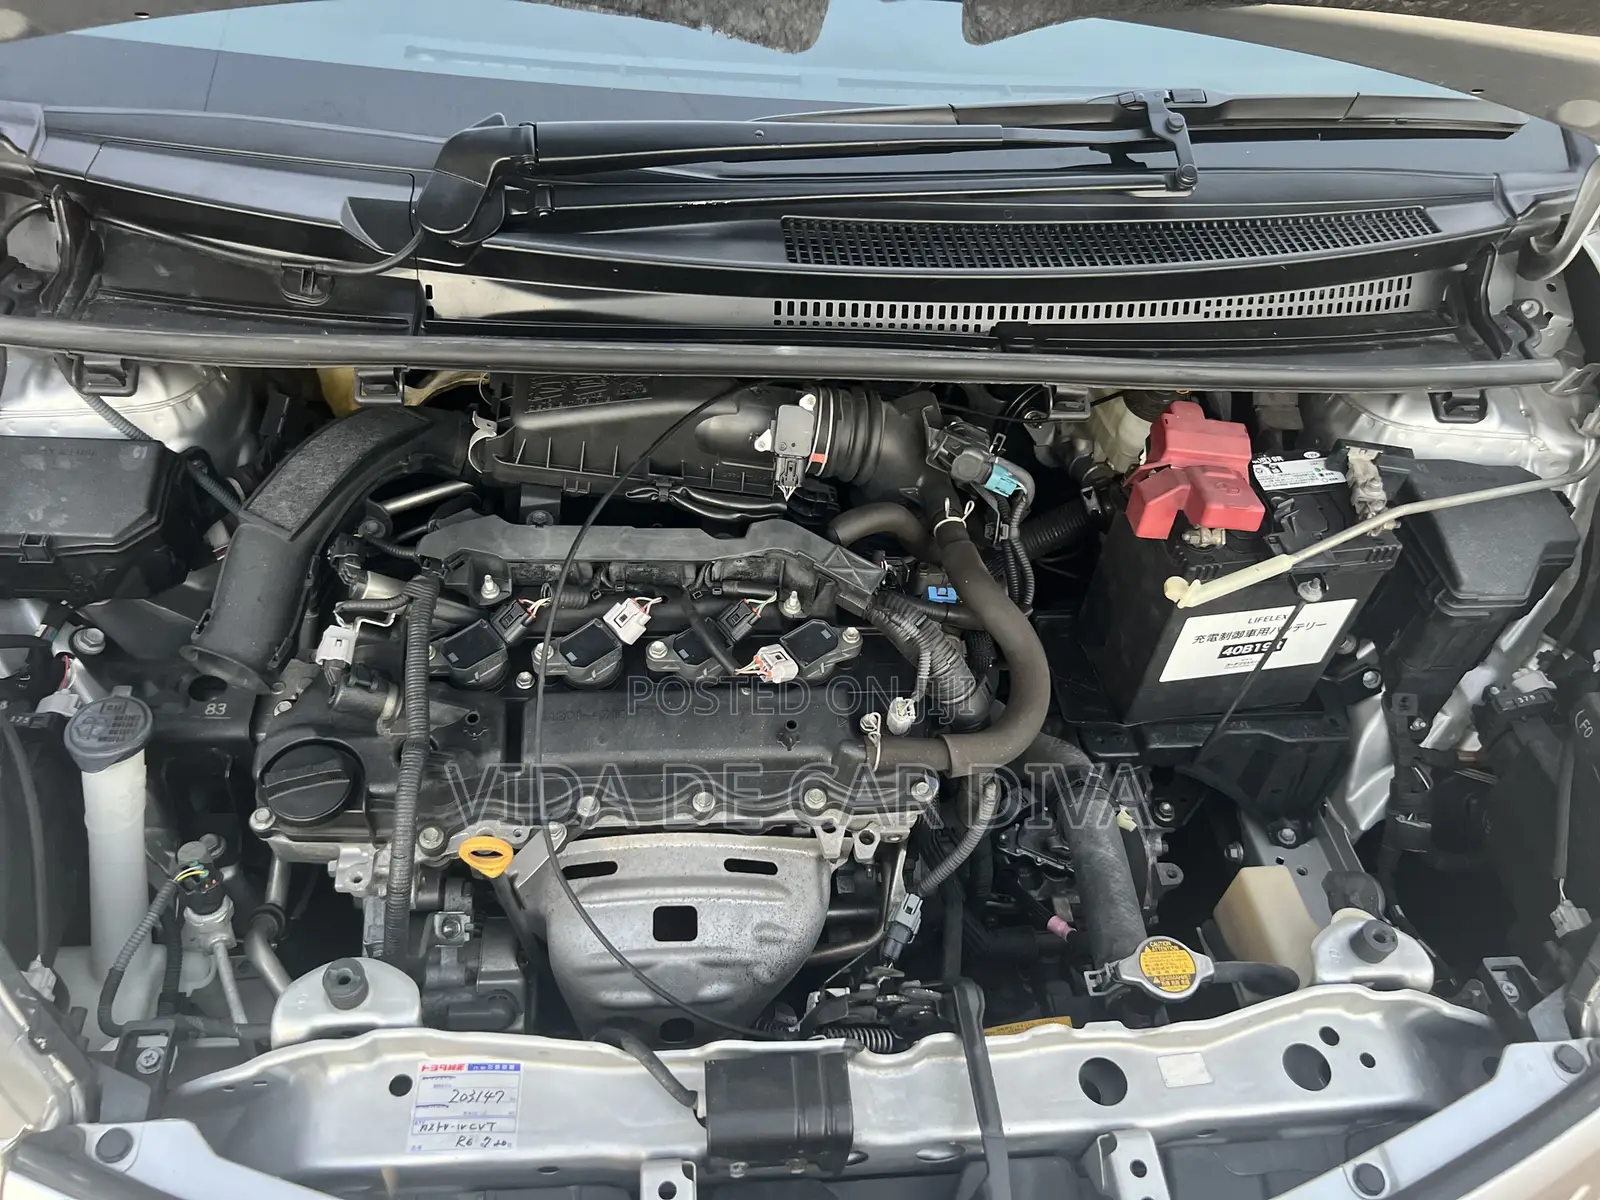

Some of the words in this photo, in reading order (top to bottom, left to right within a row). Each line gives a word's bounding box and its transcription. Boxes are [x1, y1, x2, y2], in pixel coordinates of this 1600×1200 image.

[1247, 614, 1289, 624] LIFELEX
[1191, 621, 1328, 645] 充電制御車用バテリー
[204, 702, 228, 716] 83
[448, 1088, 505, 1104] 203147
